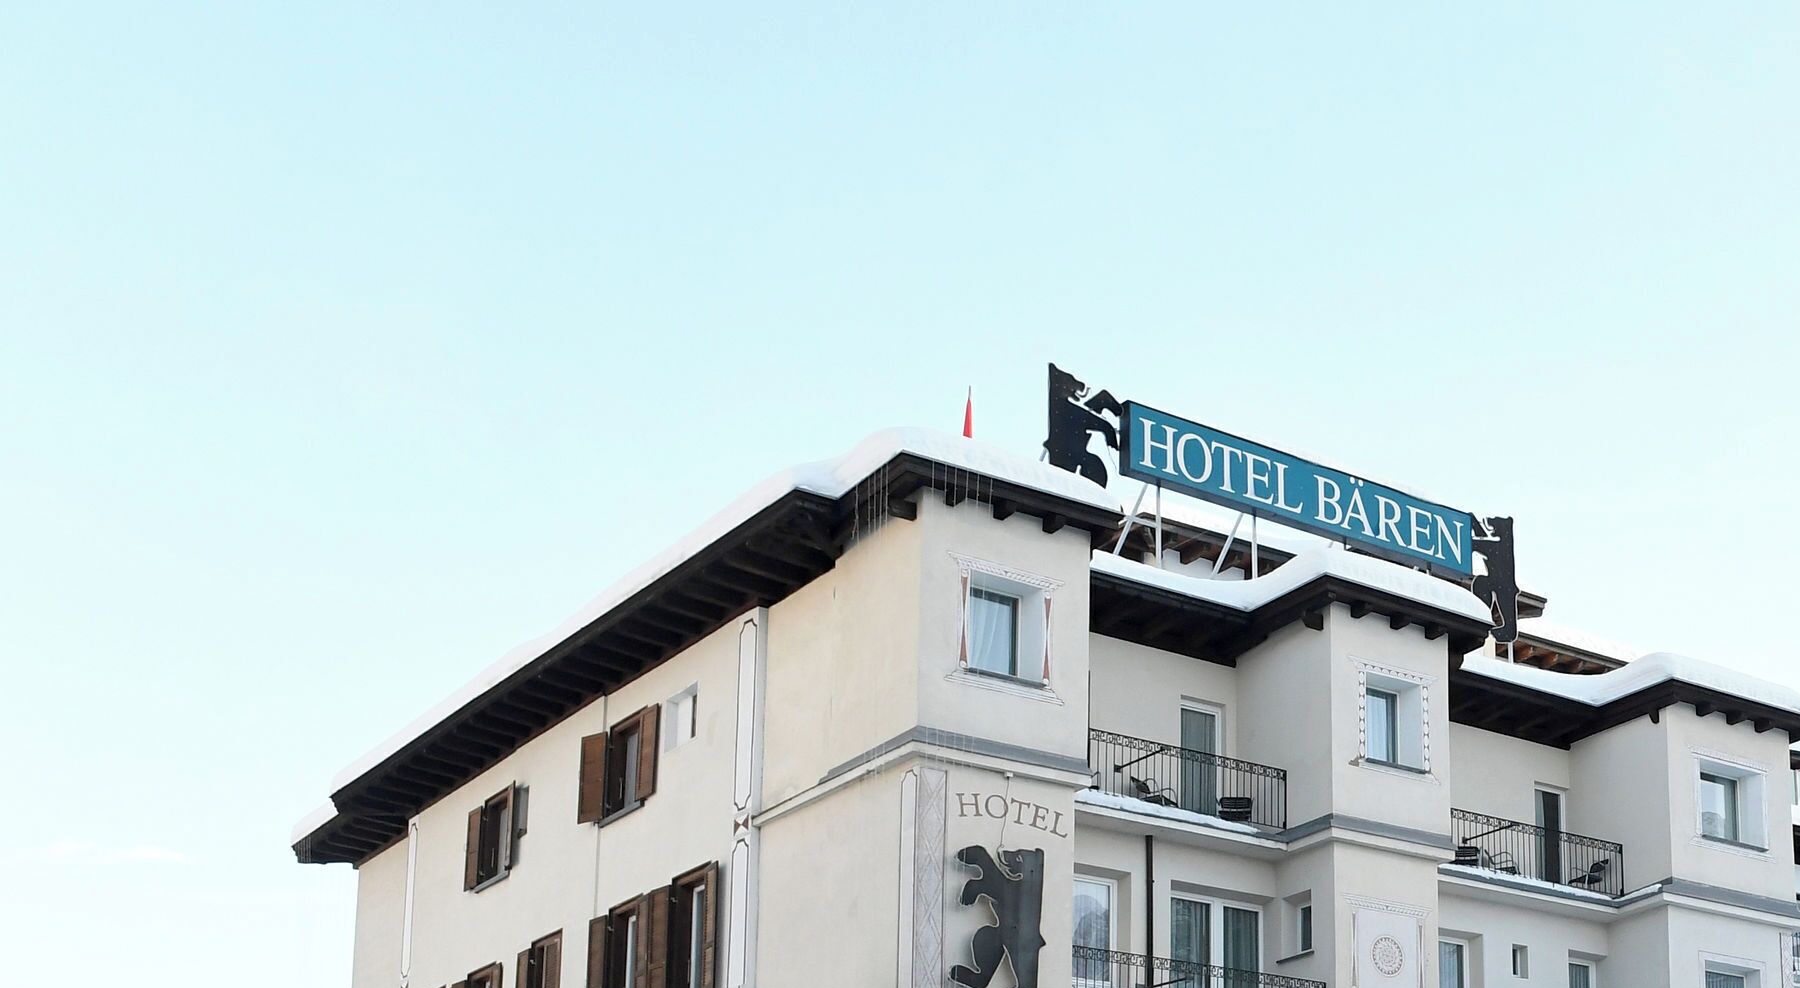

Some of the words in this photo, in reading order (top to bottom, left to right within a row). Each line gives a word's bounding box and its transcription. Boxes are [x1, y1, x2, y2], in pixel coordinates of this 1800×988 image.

[1139, 417, 1302, 514] HOTEL
[1314, 476, 1464, 565] BÄREN
[956, 793, 1068, 838] HOTEL
